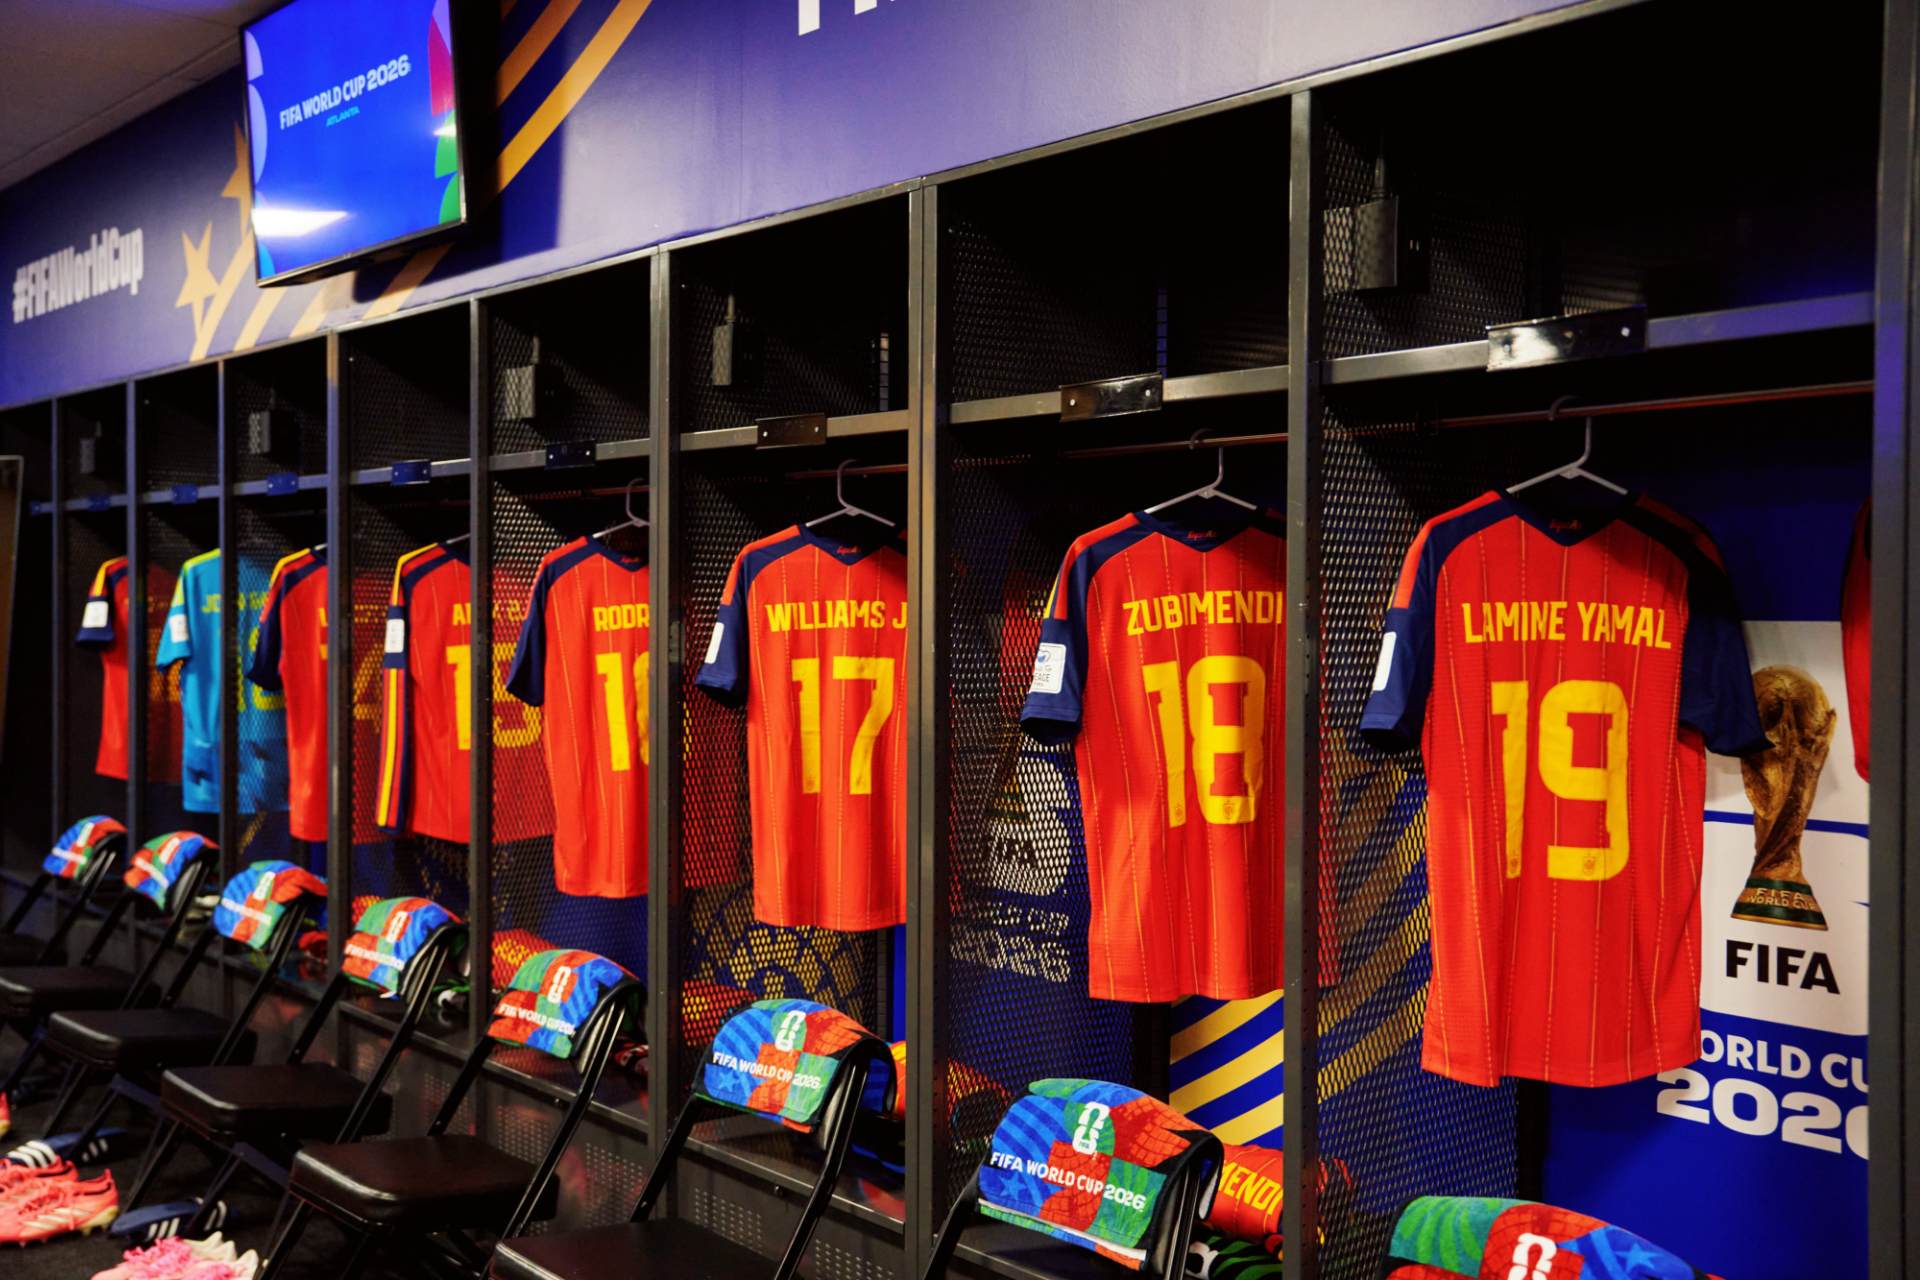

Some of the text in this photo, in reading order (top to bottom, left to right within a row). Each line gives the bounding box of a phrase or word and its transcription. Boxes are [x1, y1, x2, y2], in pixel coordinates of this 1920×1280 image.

[280, 54, 410, 130] FIFA WORLD CUP 2026
[13, 226, 144, 324] #FIFAWorldCup
[593, 603, 649, 631] RODR
[765, 600, 886, 632] WILLIAMS
[1123, 591, 1283, 636] ZUBIMENDI
[1462, 601, 1672, 649] LAMINE YAMAL
[792, 656, 895, 795] 17
[1142, 655, 1266, 828] 18
[1491, 679, 1630, 881] 19
[1756, 887, 1804, 901] FIFA
[1726, 940, 1840, 995] FIFA
[712, 1051, 738, 1070] FIFA
[738, 1060, 776, 1078] WORLD
[792, 1073, 821, 1090] 2026
[1700, 1030, 1869, 1093] ORLD CU
[989, 1151, 1146, 1211] FIFA WORLD CUP 2026
